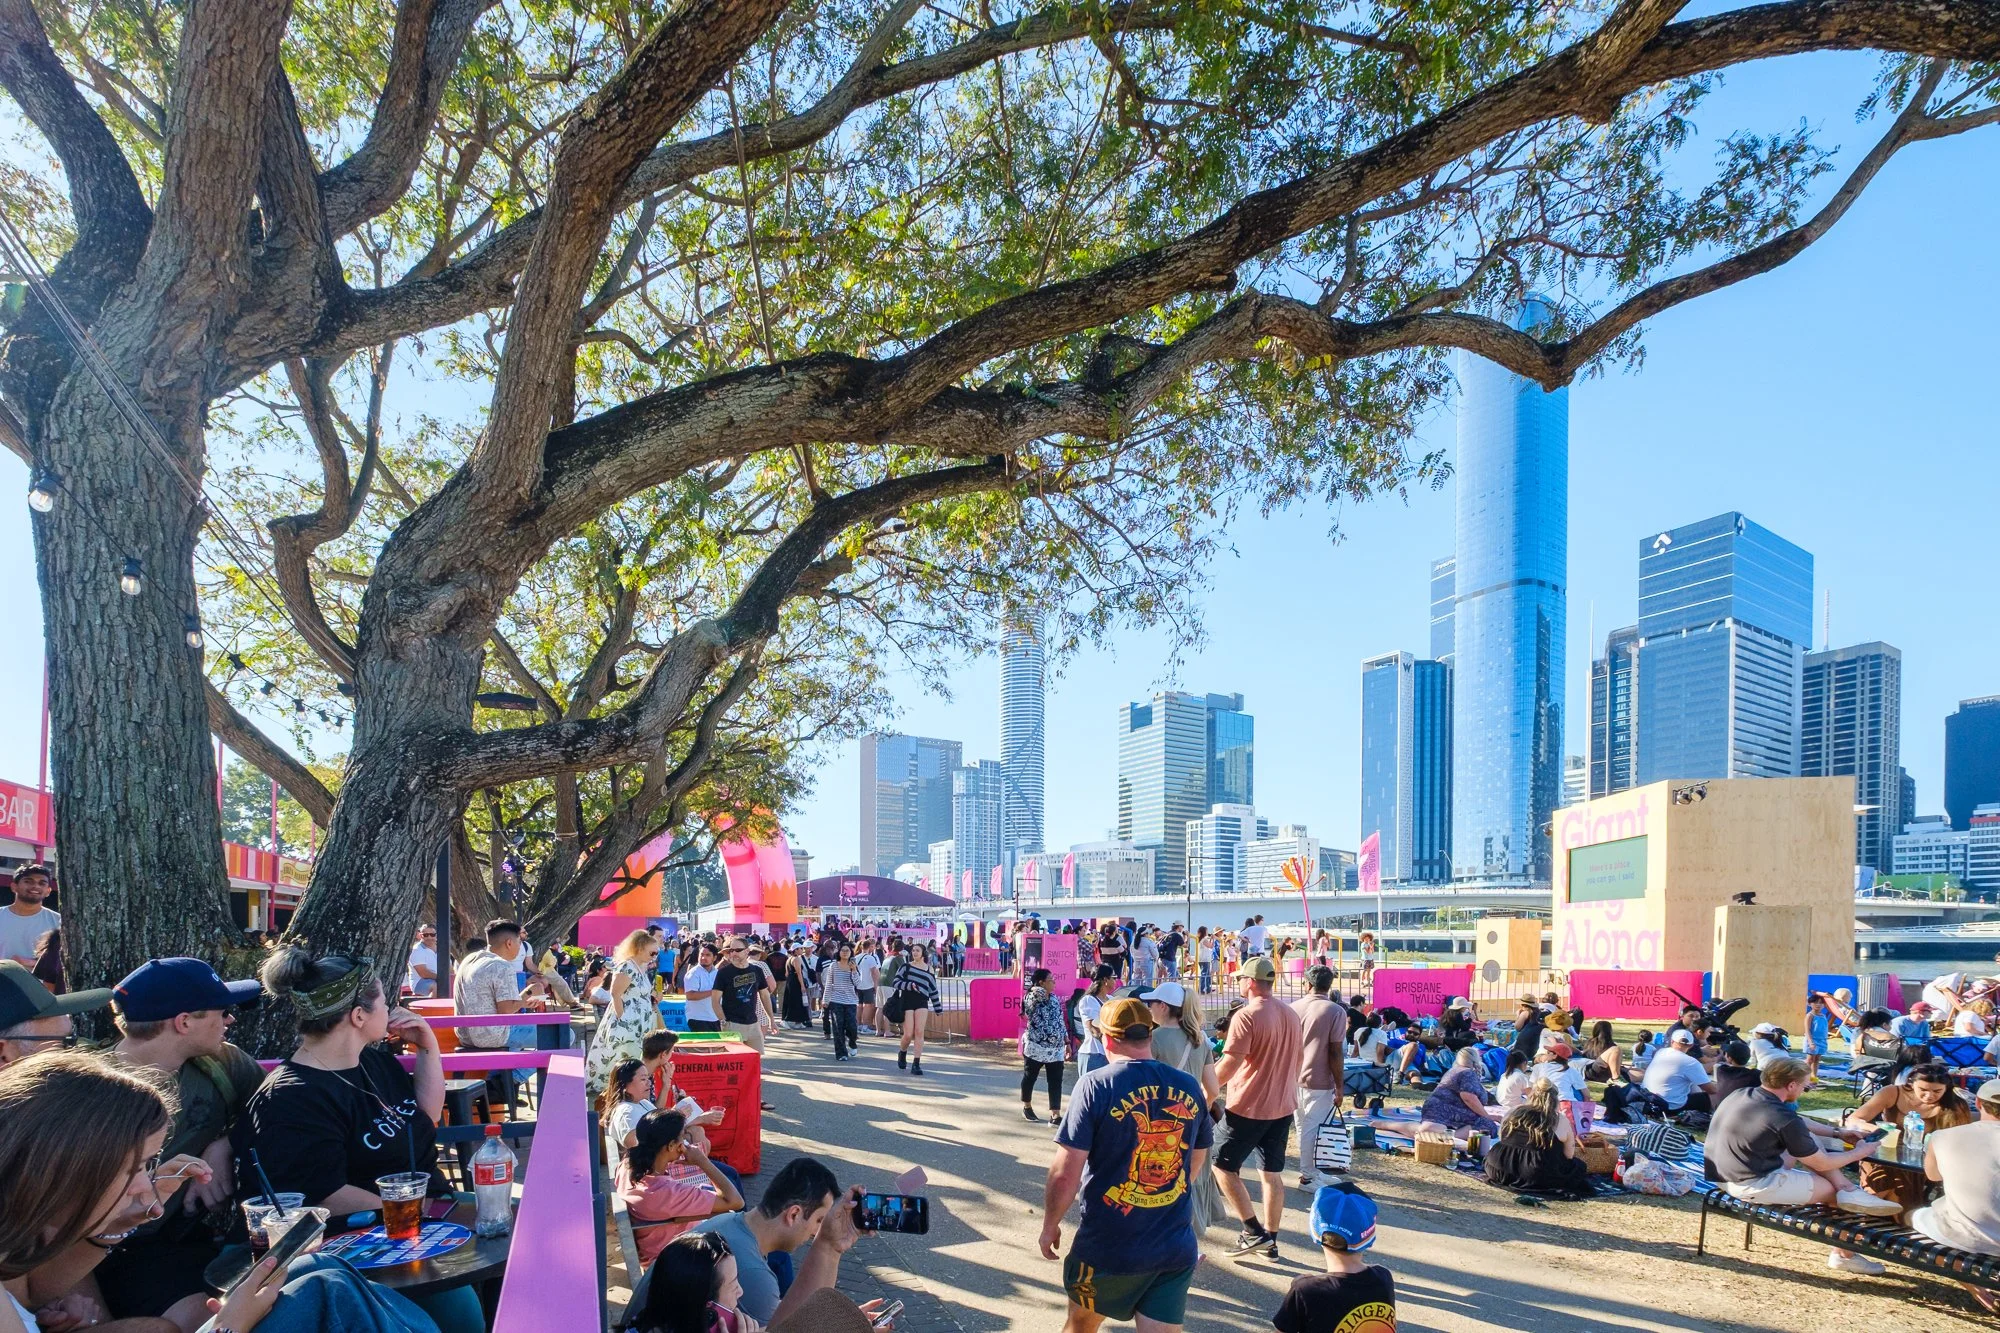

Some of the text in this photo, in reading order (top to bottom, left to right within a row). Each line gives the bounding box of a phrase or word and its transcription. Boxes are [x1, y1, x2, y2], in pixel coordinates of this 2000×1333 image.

[1559, 919, 1662, 969] Along
[1047, 950, 1075, 958] SWITCH
[1395, 983, 1442, 993] BRISBANE
[1597, 985, 1662, 995] BRISBANE
[1410, 994, 1447, 1004] ESTIVAL
[1617, 996, 1677, 1006] FESTIVAL
[675, 1061, 744, 1073] GENERAL WASTE
[1110, 1085, 1200, 1121] SALTY LIFE
